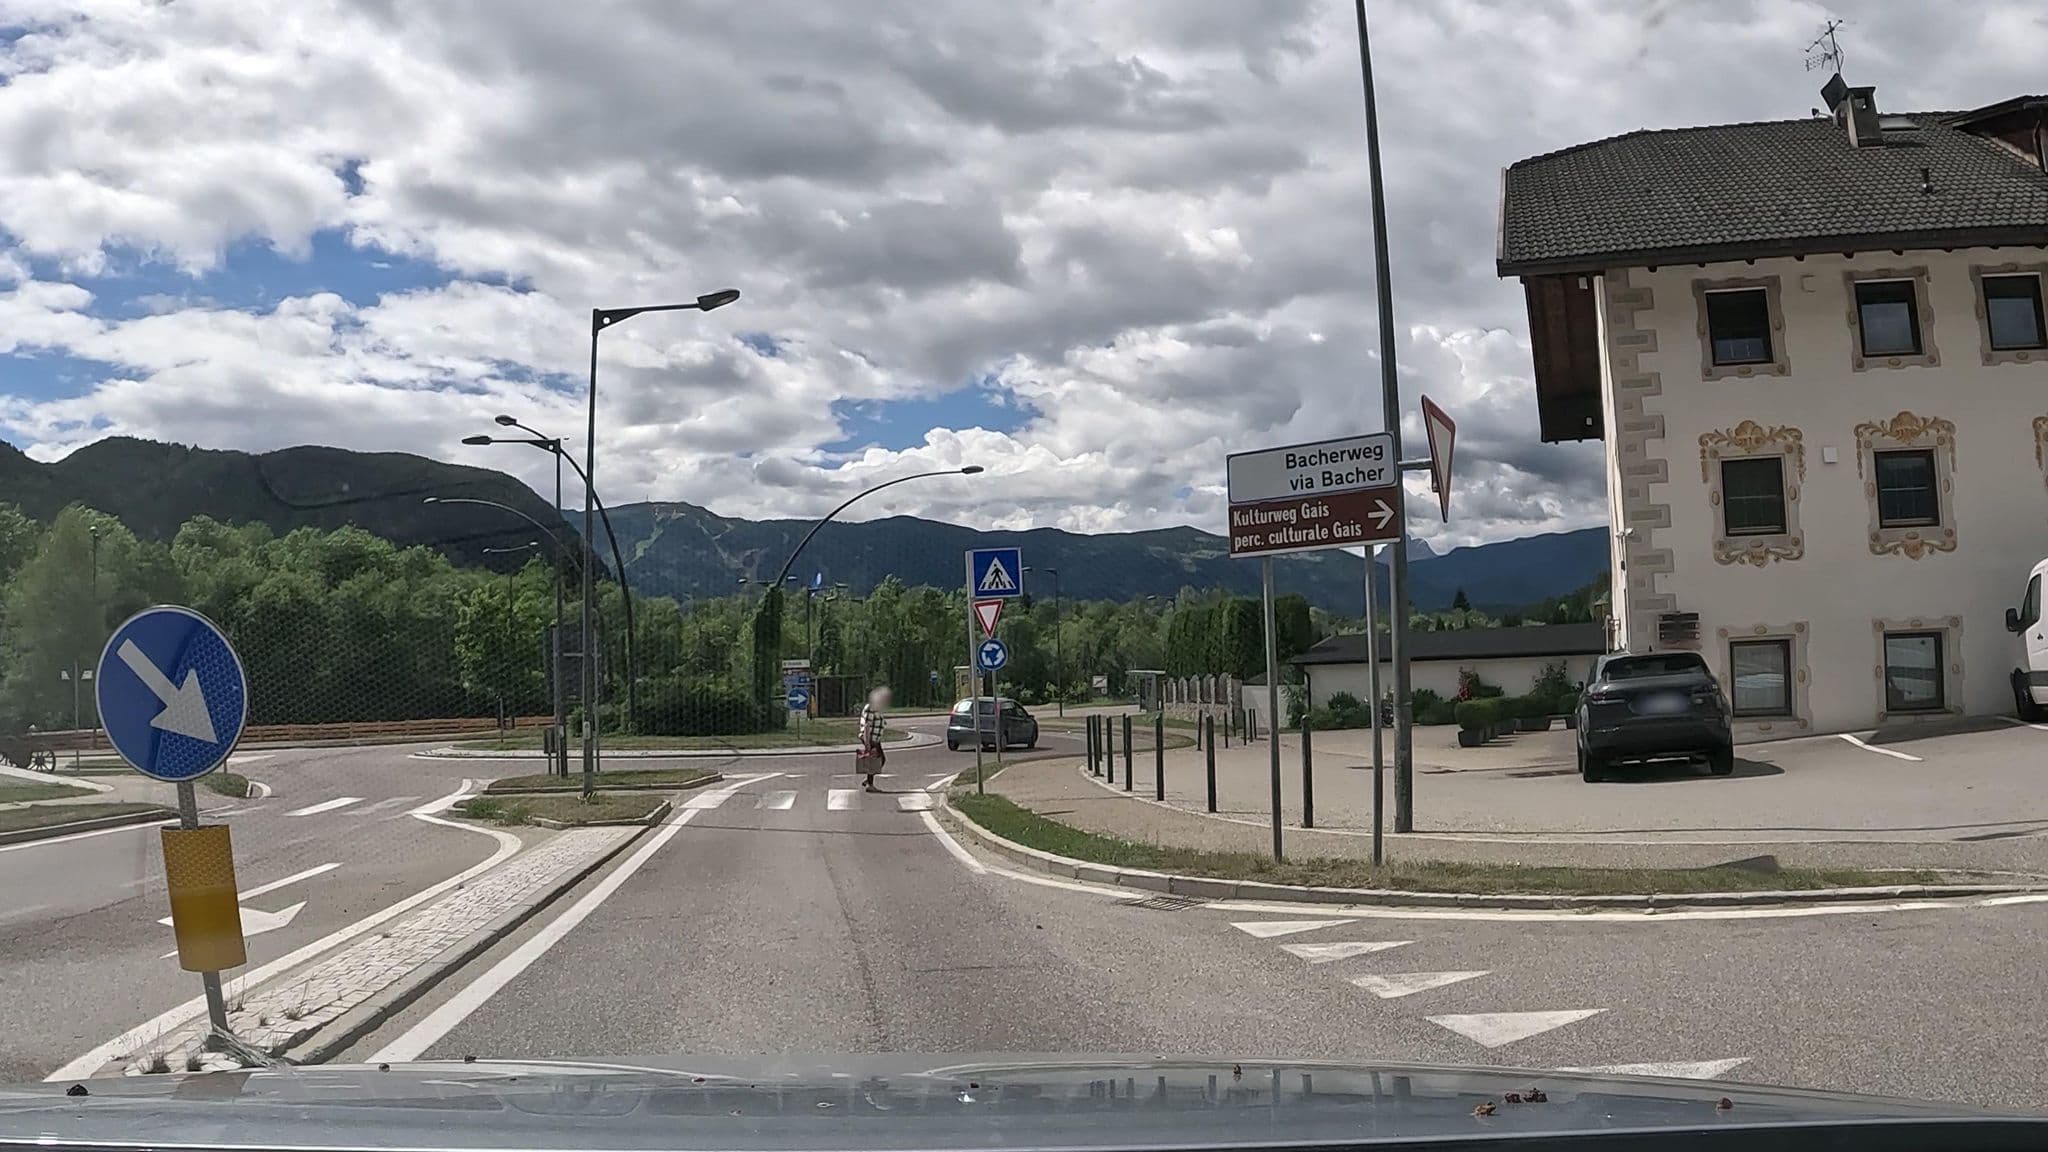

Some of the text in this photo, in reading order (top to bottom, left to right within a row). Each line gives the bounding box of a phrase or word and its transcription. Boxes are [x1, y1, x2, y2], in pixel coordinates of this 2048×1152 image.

[1286, 444, 1384, 469] Bacherweg
[1290, 468, 1384, 491] via Bacher
[1233, 501, 1330, 527] Kulturweg Gais
[1234, 521, 1362, 552] perc. culturale Gais
